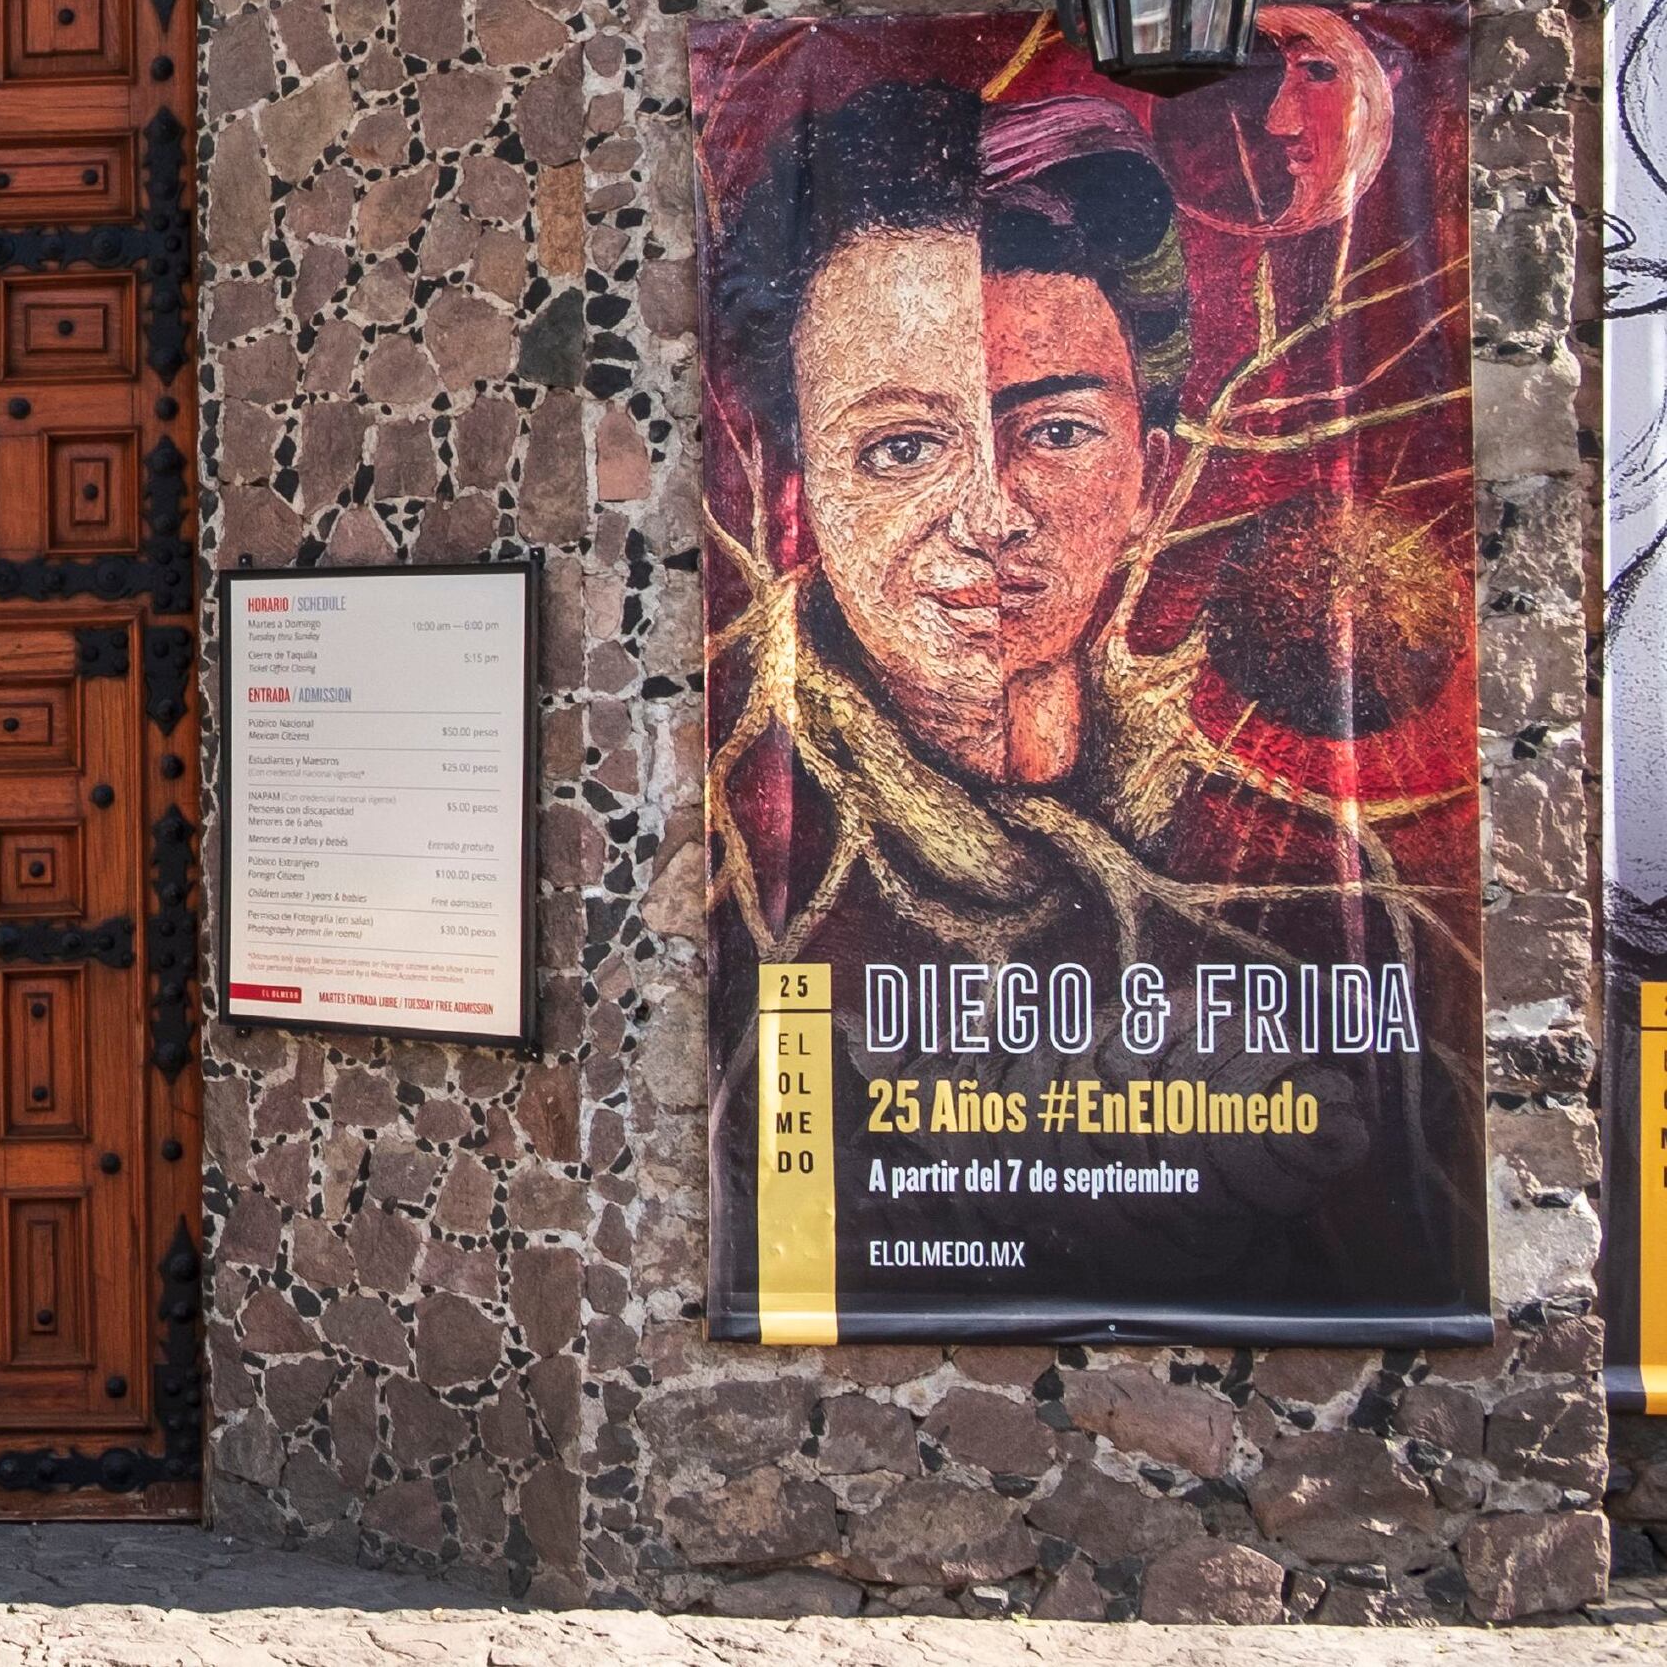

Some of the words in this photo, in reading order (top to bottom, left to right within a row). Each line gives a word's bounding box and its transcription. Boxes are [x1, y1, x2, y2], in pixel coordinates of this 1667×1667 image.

[248, 597, 289, 612] HORARIO
[297, 596, 346, 611] SCHEDULE
[248, 620, 276, 629] Martes
[285, 620, 321, 630] Domingo
[412, 621, 435, 631] 10:00
[464, 620, 483, 631] 6:00
[485, 622, 499, 631] pm
[286, 651, 317, 662] Taquilla
[464, 653, 482, 663] 5:15
[485, 655, 499, 664] pm
[248, 687, 290, 703] ENTRADA
[298, 686, 351, 703] ADMISSION
[473, 729, 499, 738] pesos
[473, 765, 499, 775] pesos
[248, 791, 280, 801] INAPAM
[286, 806, 301, 814] con
[302, 806, 354, 816] discapacidad
[447, 802, 471, 812] $5.00
[472, 805, 499, 814] pesos
[436, 870, 469, 880] $100.00
[471, 872, 497, 882] pesos
[441, 925, 469, 936] $30.00
[471, 927, 496, 937] pesos
[779, 974, 810, 999] 25
[319, 991, 346, 1004] MARTES
[347, 993, 377, 1007] ENTRADA
[379, 996, 398, 1009] LIBRE
[404, 998, 434, 1011] TUESDAY
[436, 1000, 453, 1013] FREE
[454, 1001, 494, 1015] ADMISSION
[866, 963, 1093, 1055] DIEGO
[1121, 962, 1171, 1055] &
[1197, 963, 1420, 1055] FRIDA
[777, 1032, 811, 1056] EL
[868, 1078, 920, 1134] 25
[930, 1078, 1028, 1134] Años
[1037, 1079, 1319, 1136] #EnElOlmedo
[869, 1160, 886, 1193] A
[891, 1159, 959, 1199] partir
[964, 1159, 1002, 1193] del
[1007, 1160, 1021, 1193] 7
[1029, 1159, 1058, 1194] de
[1063, 1159, 1200, 1199] septiembre
[869, 1240, 1026, 1268] ELOLMEDO.MX
